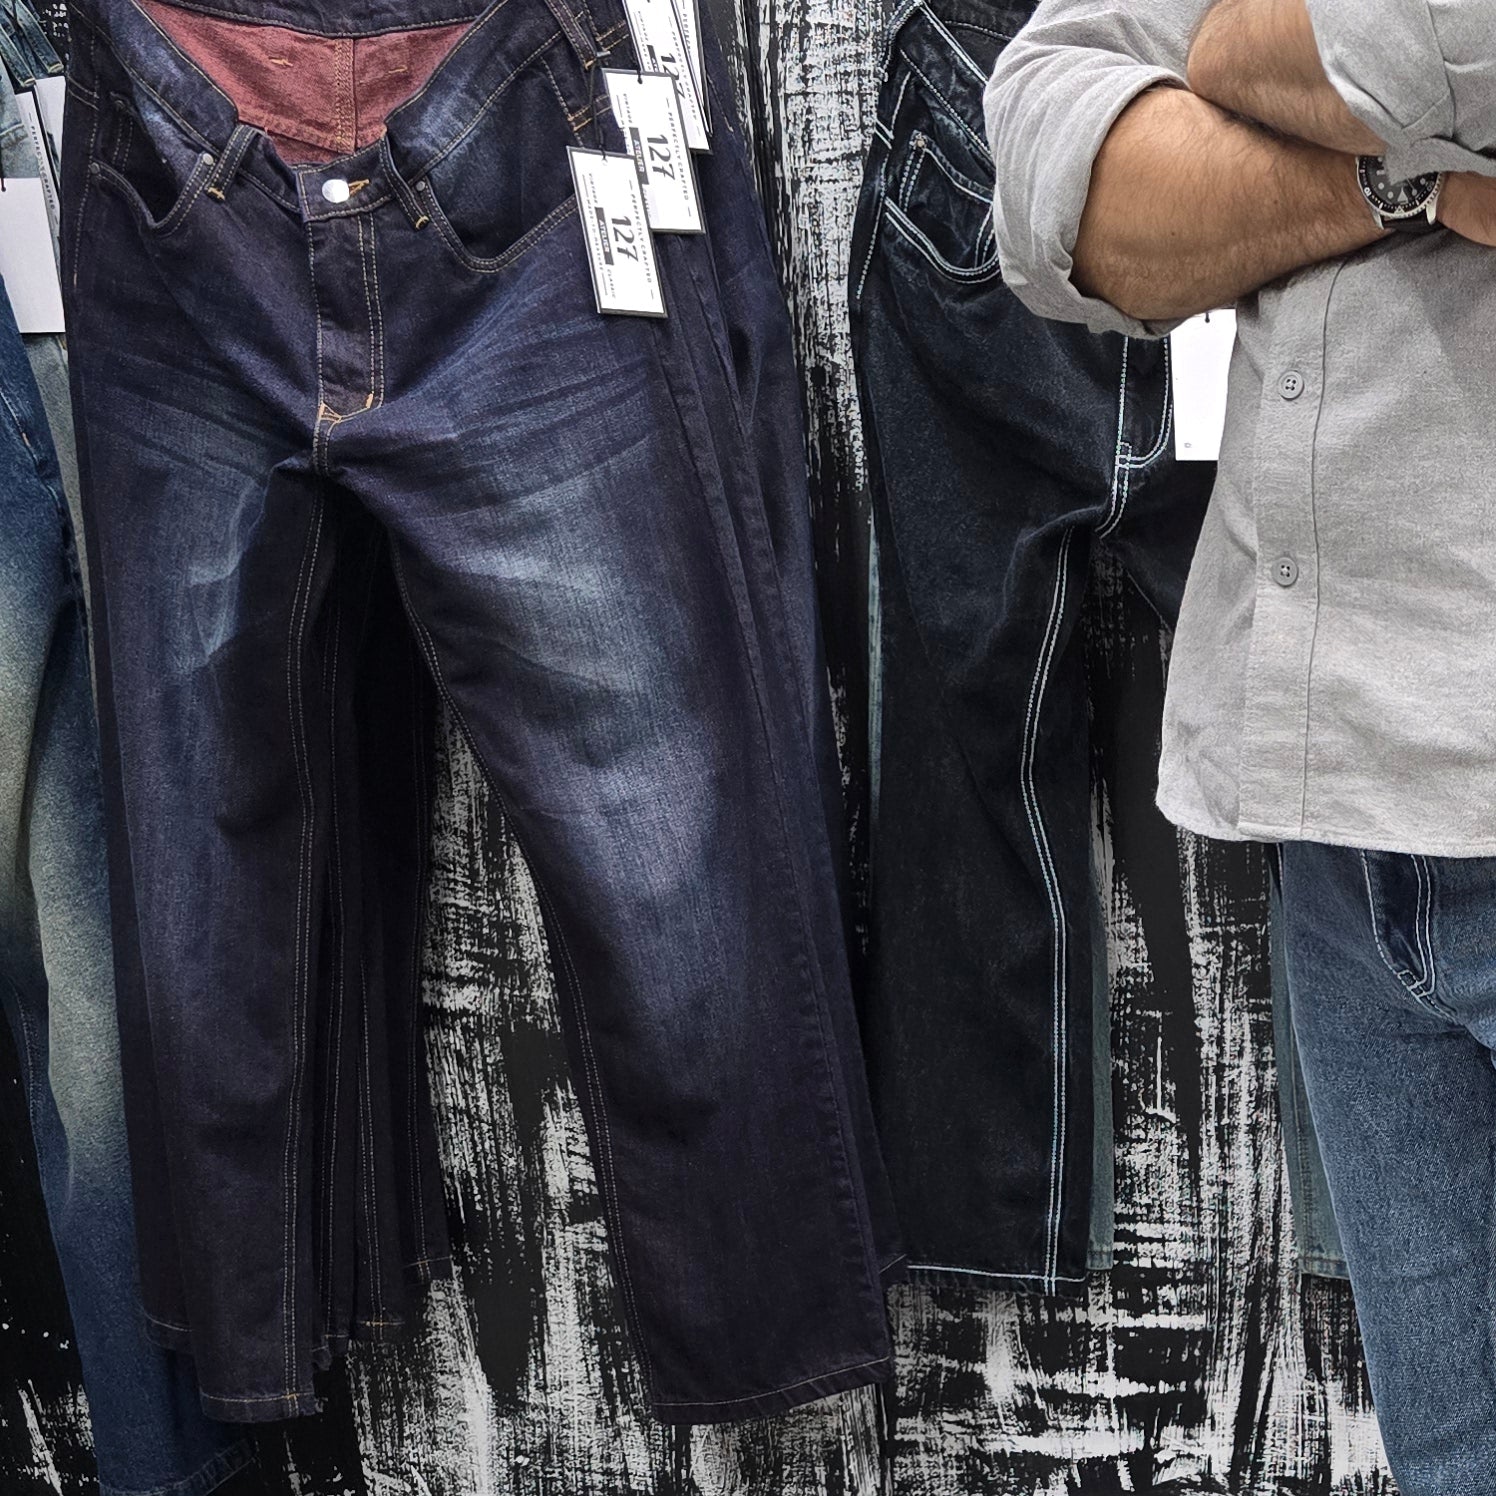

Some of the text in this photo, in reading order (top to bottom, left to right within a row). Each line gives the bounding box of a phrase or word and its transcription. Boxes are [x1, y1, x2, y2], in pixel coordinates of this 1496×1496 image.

[633, 139, 646, 174] ATELIER
[647, 134, 676, 181] 127
[667, 111, 690, 201] PERFECTLY CRAFTED
[598, 219, 610, 254] ATELIER
[611, 215, 639, 263] 127
[631, 193, 653, 283] PERFECTLY CRAFTED
